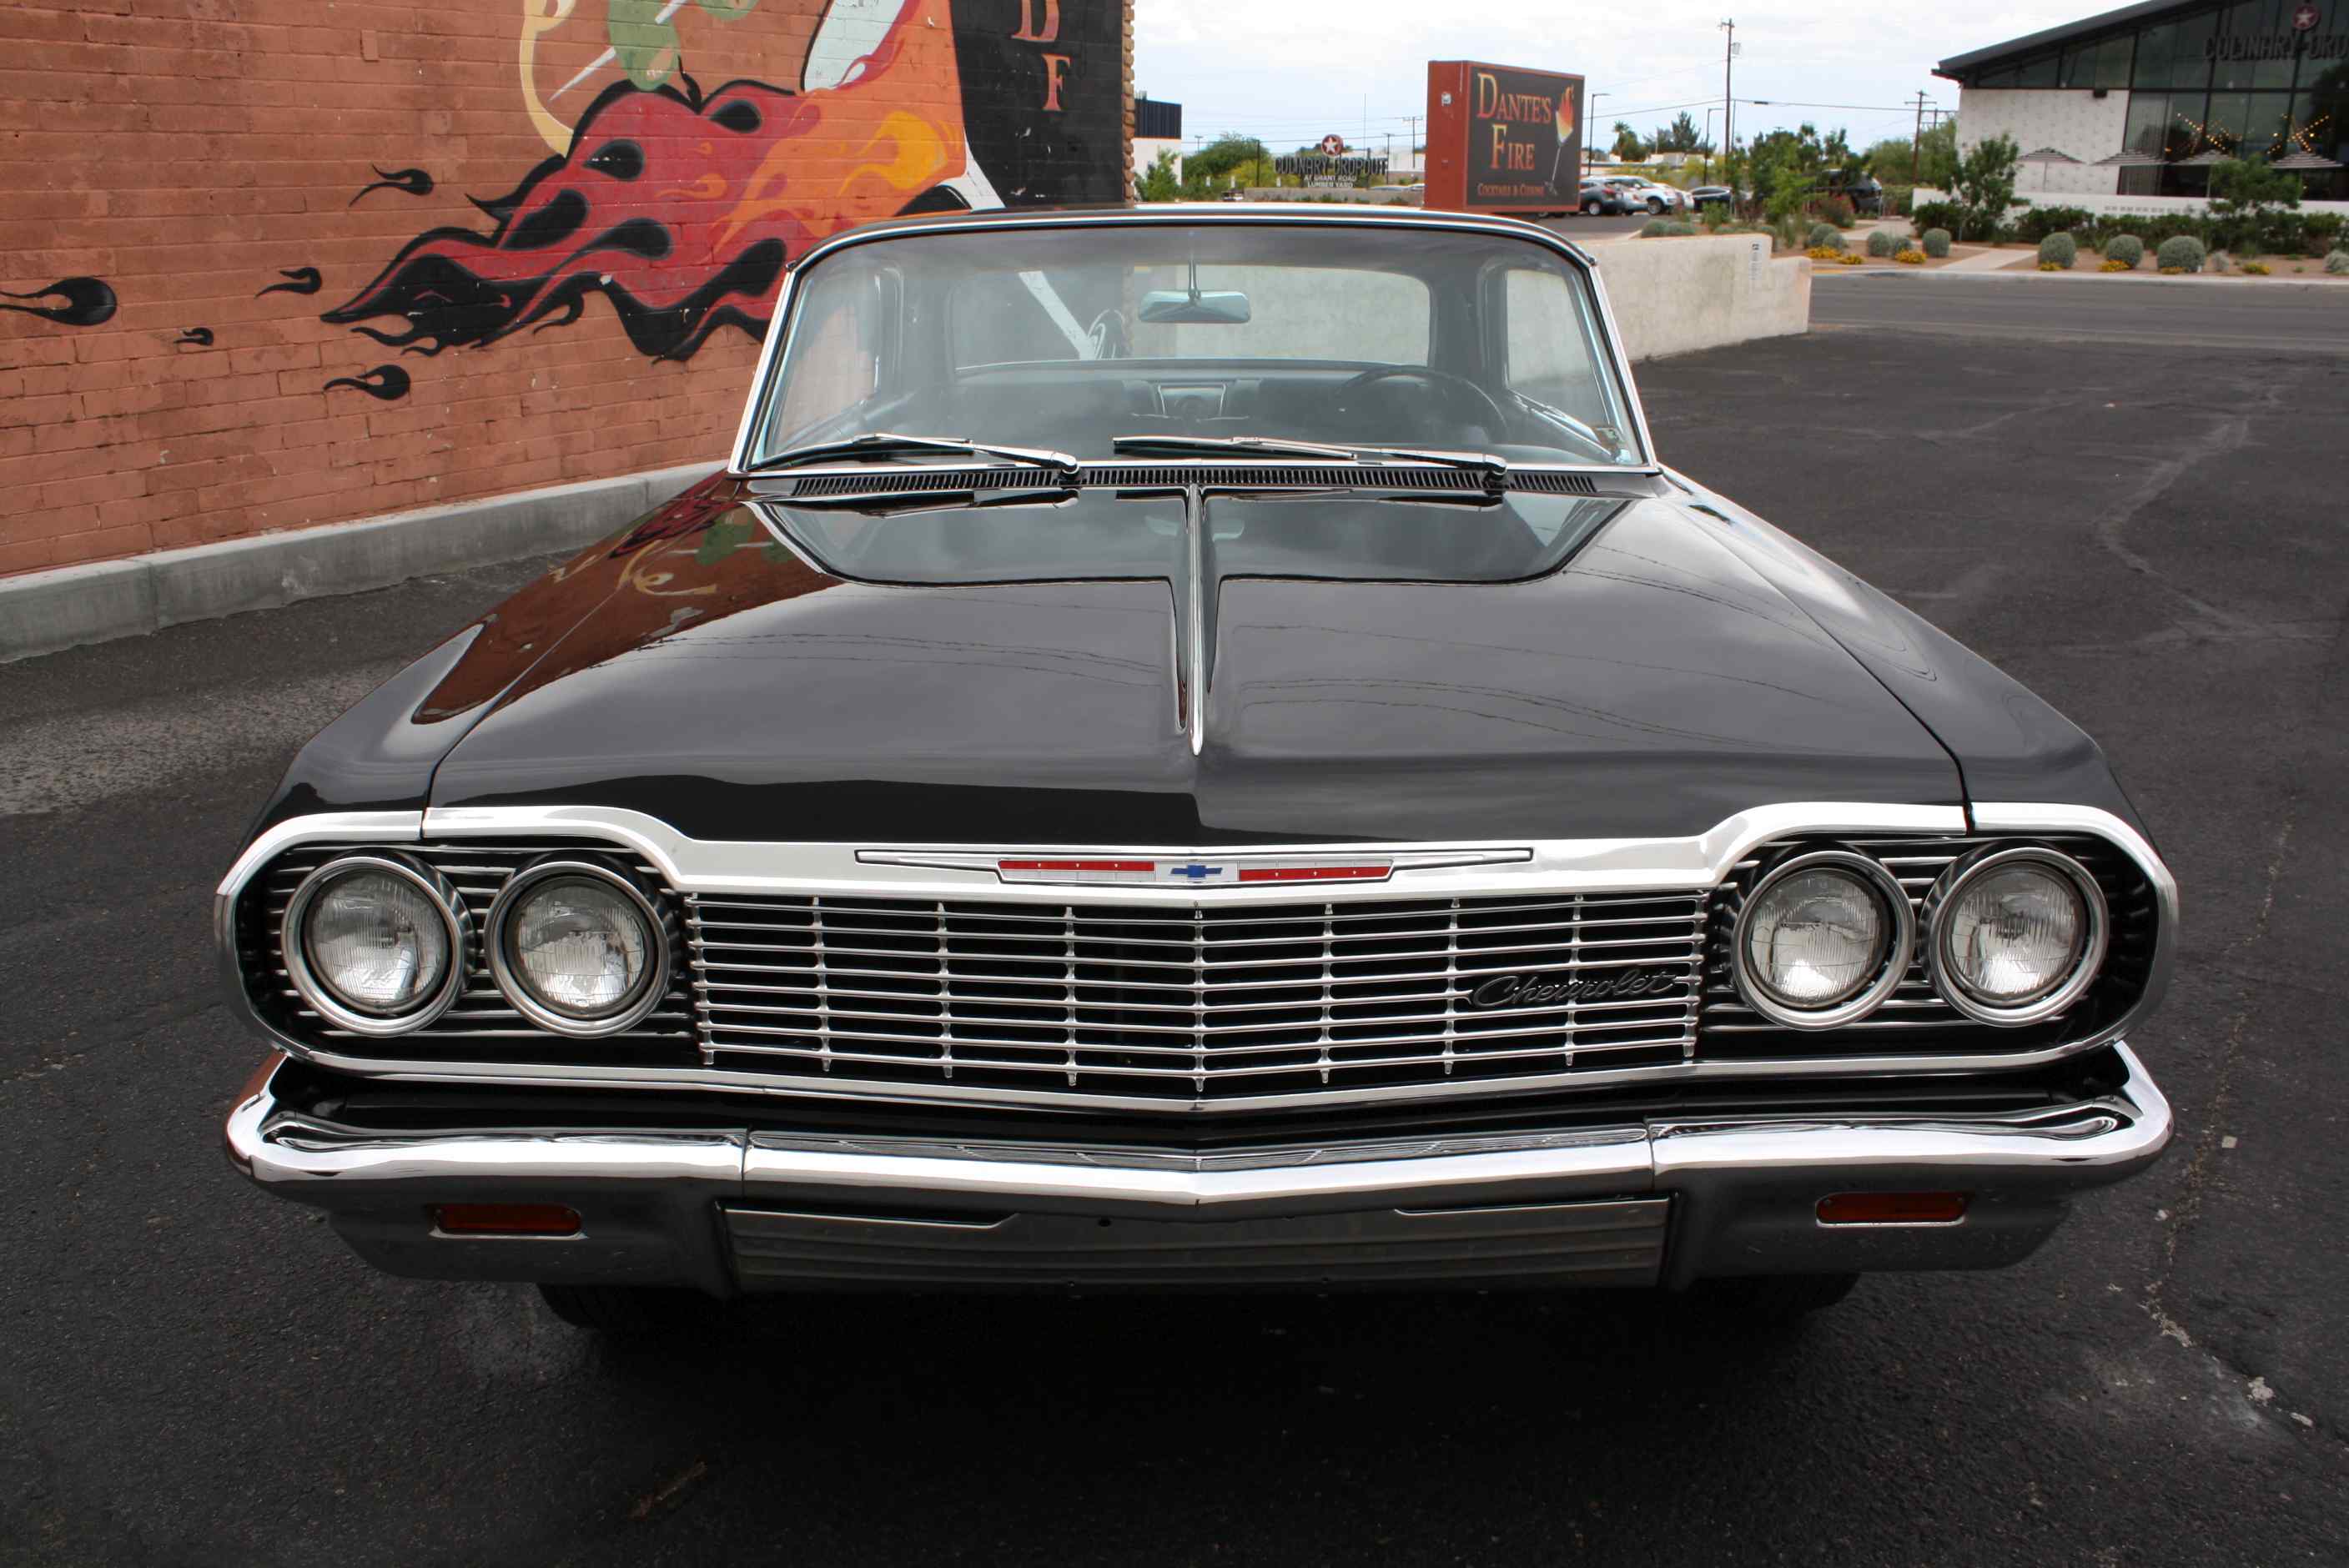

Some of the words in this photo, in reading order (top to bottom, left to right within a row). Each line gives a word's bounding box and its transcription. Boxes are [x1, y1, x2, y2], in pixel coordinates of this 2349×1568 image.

[1042, 53, 1071, 112] F
[1274, 157, 1330, 175] CULINARY
[1334, 158, 1388, 175] DROPOUT
[1490, 123, 1536, 171] FIRE
[1472, 968, 1677, 1008] Chevrolet
